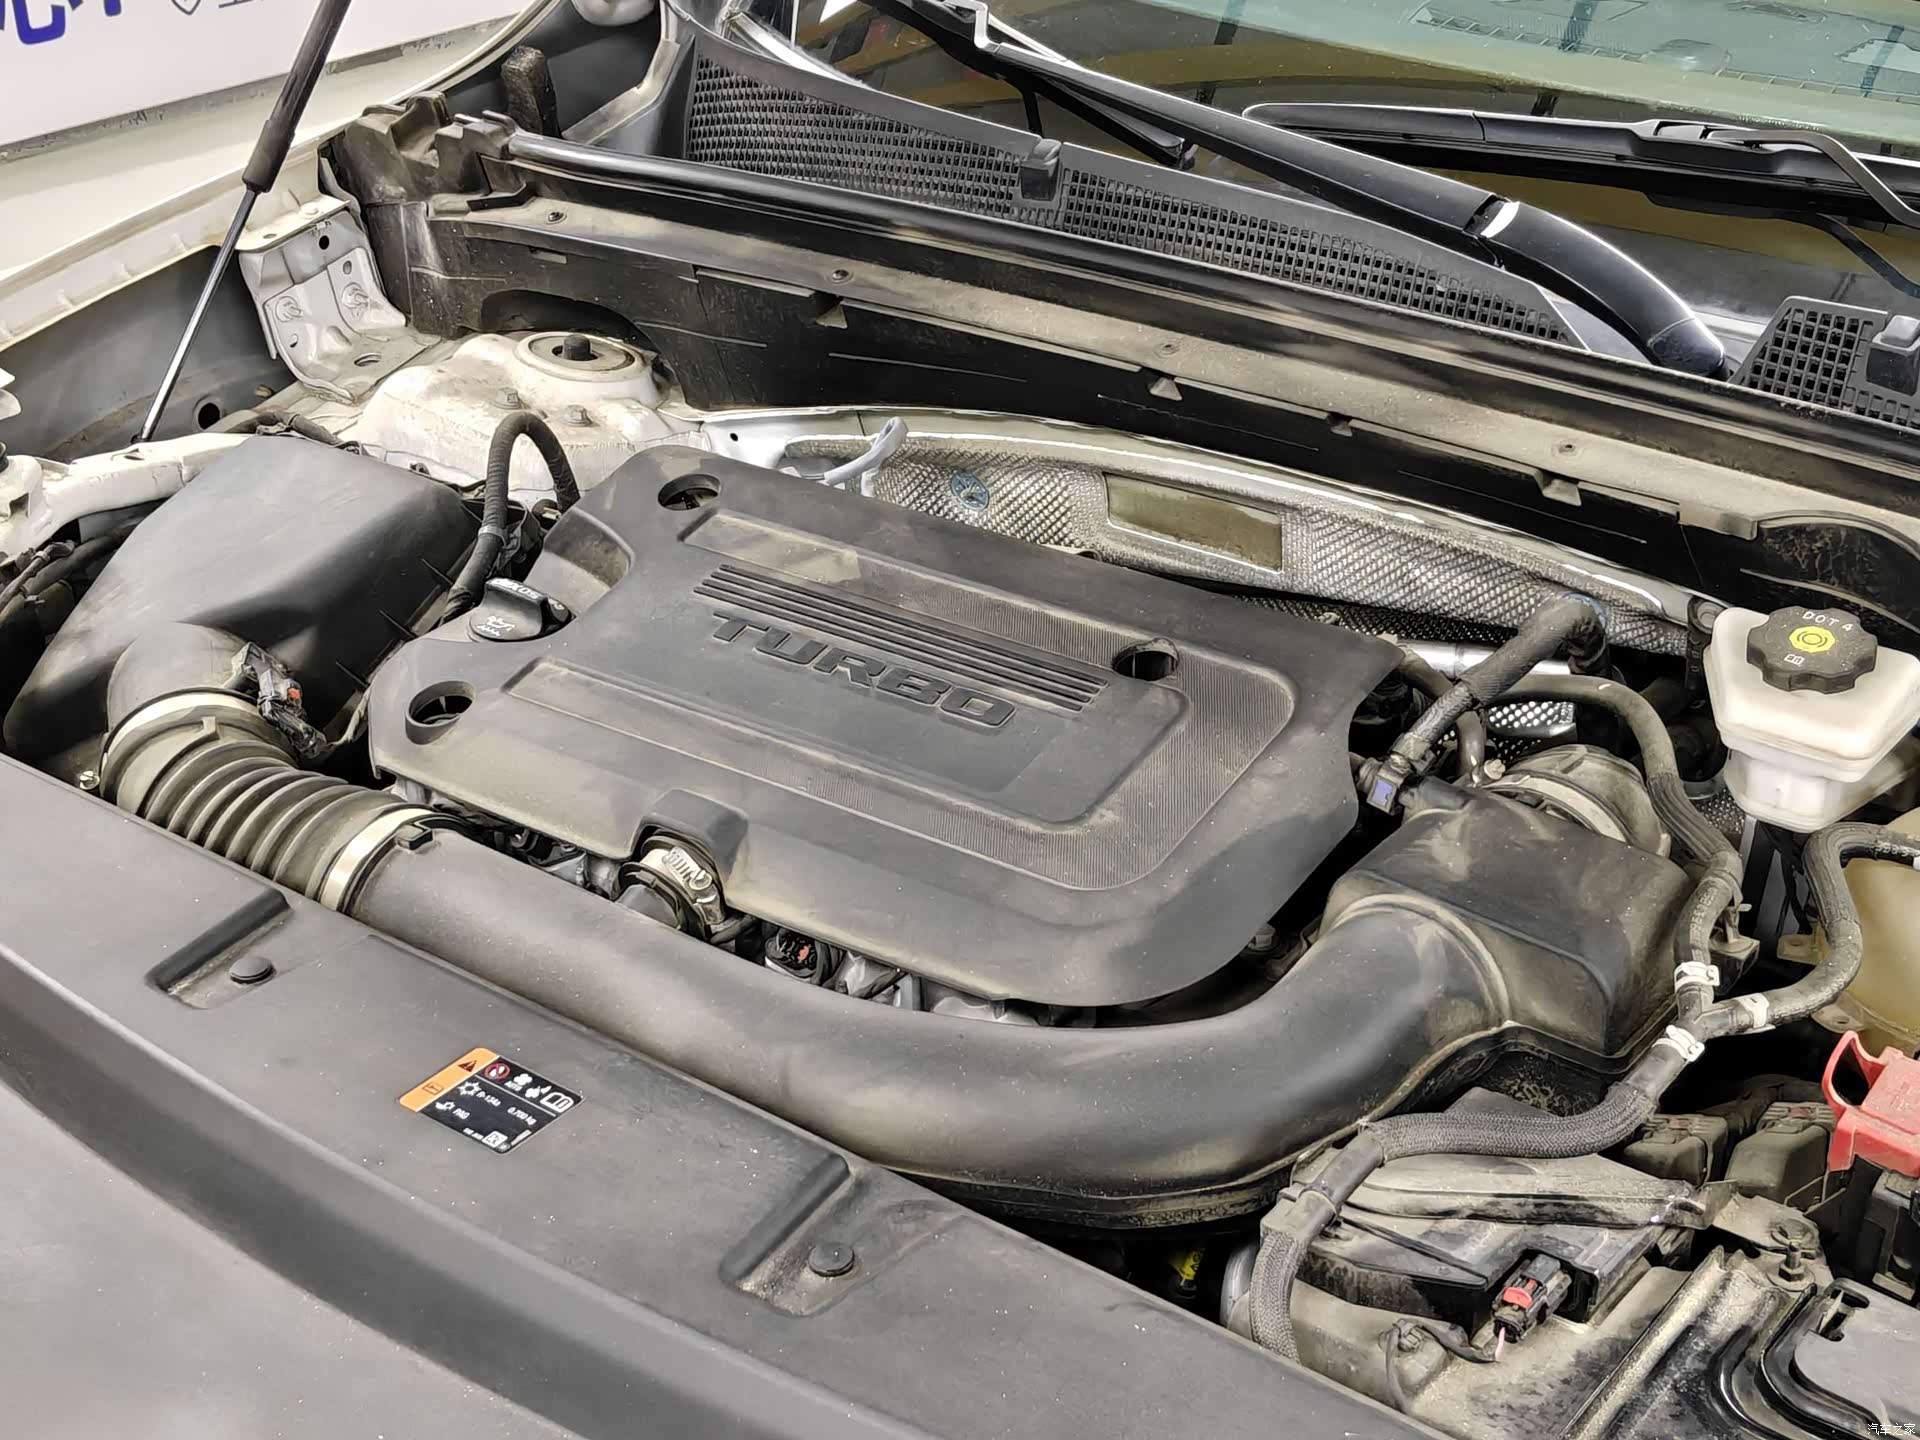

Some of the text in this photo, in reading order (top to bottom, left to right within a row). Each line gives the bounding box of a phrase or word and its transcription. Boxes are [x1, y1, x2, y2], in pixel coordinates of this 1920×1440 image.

[1802, 611, 1853, 632] DOT 4
[711, 611, 1017, 729] TURBO
